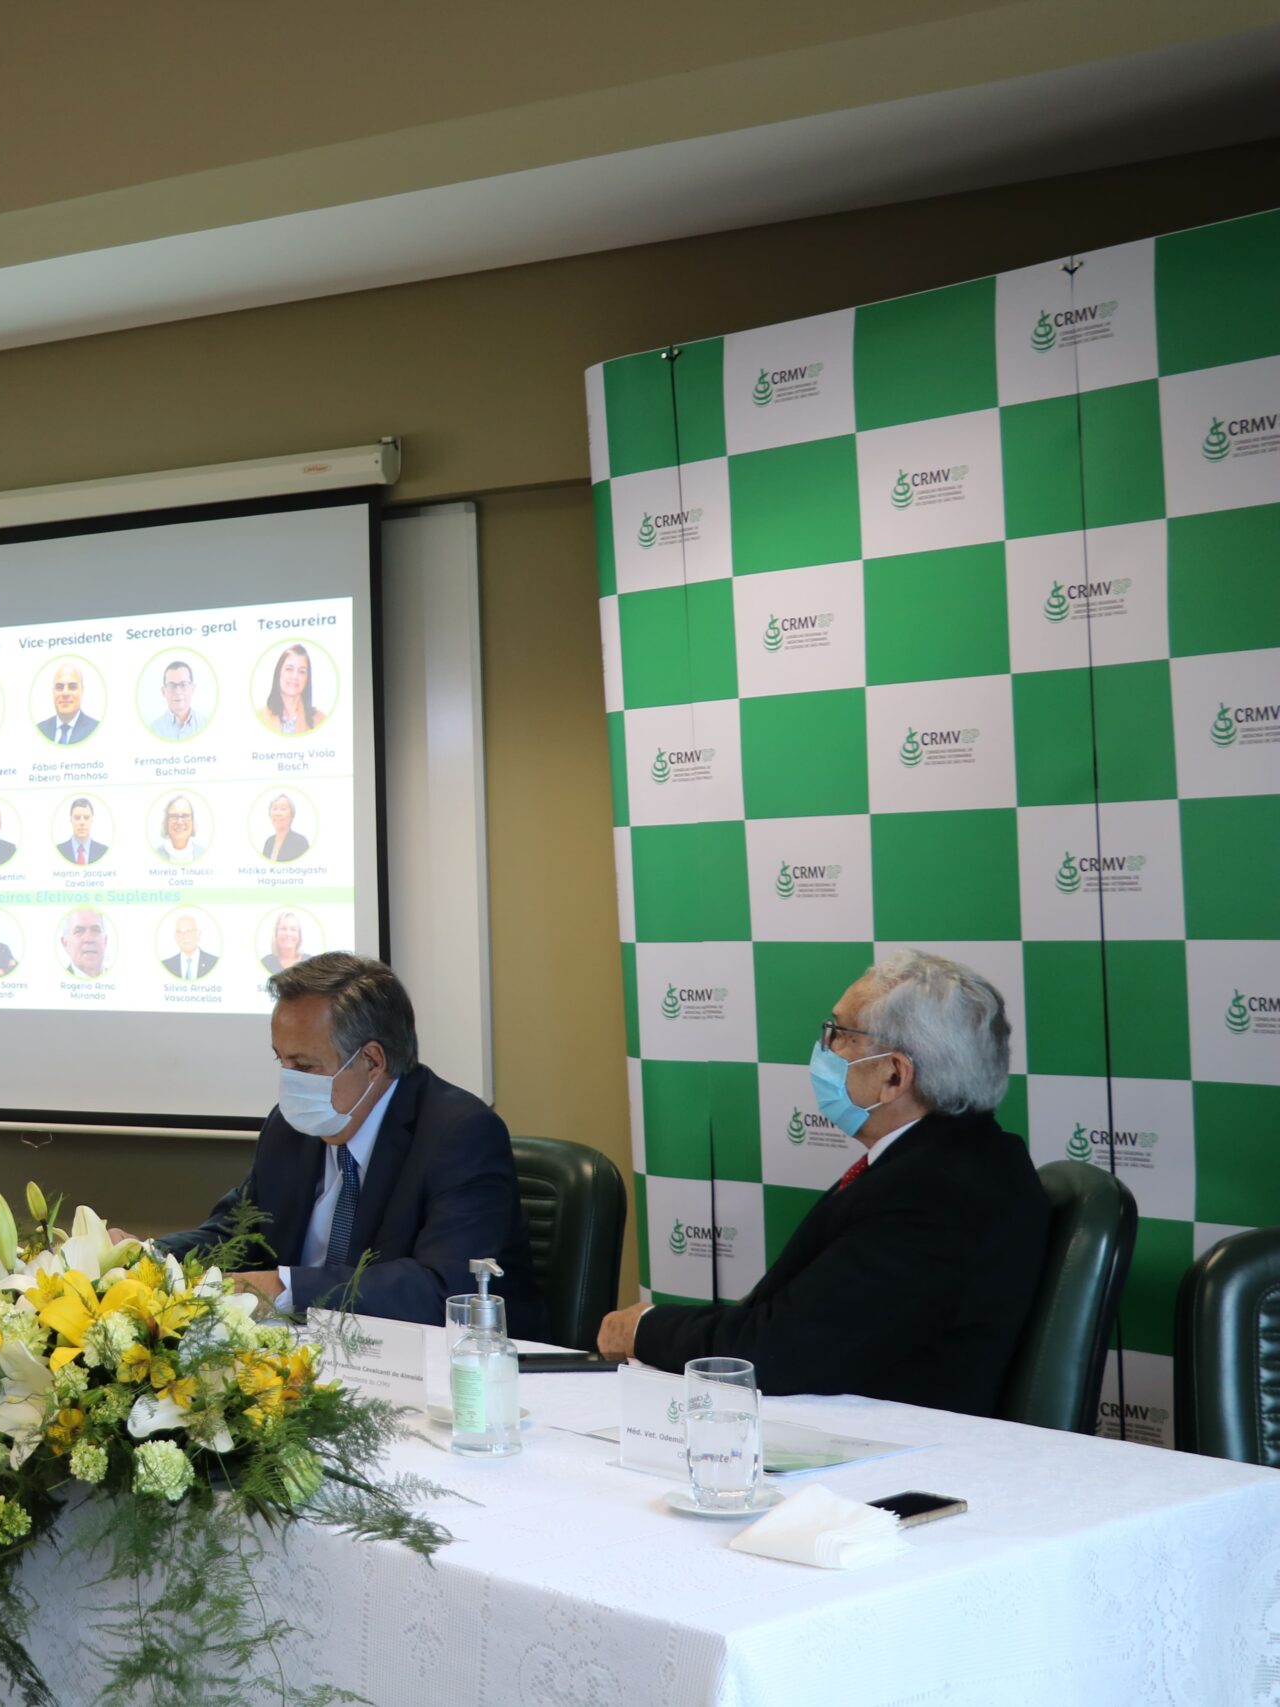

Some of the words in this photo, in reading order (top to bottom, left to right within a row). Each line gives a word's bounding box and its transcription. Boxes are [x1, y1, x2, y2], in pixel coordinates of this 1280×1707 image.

[1228, 414, 1280, 436] CRMV
[201, 619, 237, 637] geral
[257, 613, 337, 630] Tesoureira
[19, 632, 113, 649] Vice-presidente
[134, 755, 181, 766] Fernando
[183, 755, 217, 765] Gomes
[251, 751, 304, 762] Rosemary
[307, 748, 336, 758] Viola
[60, 760, 104, 770] Fernando
[277, 761, 309, 771] Bosch
[29, 772, 61, 782] Ribeiro
[64, 772, 108, 781] Manhoso
[36, 891, 90, 903] Efetivos
[95, 894, 102, 902] e
[107, 890, 180, 904] Suplentes
[626, 1427, 642, 1436] Méd.
[644, 1430, 658, 1439] Vet.
